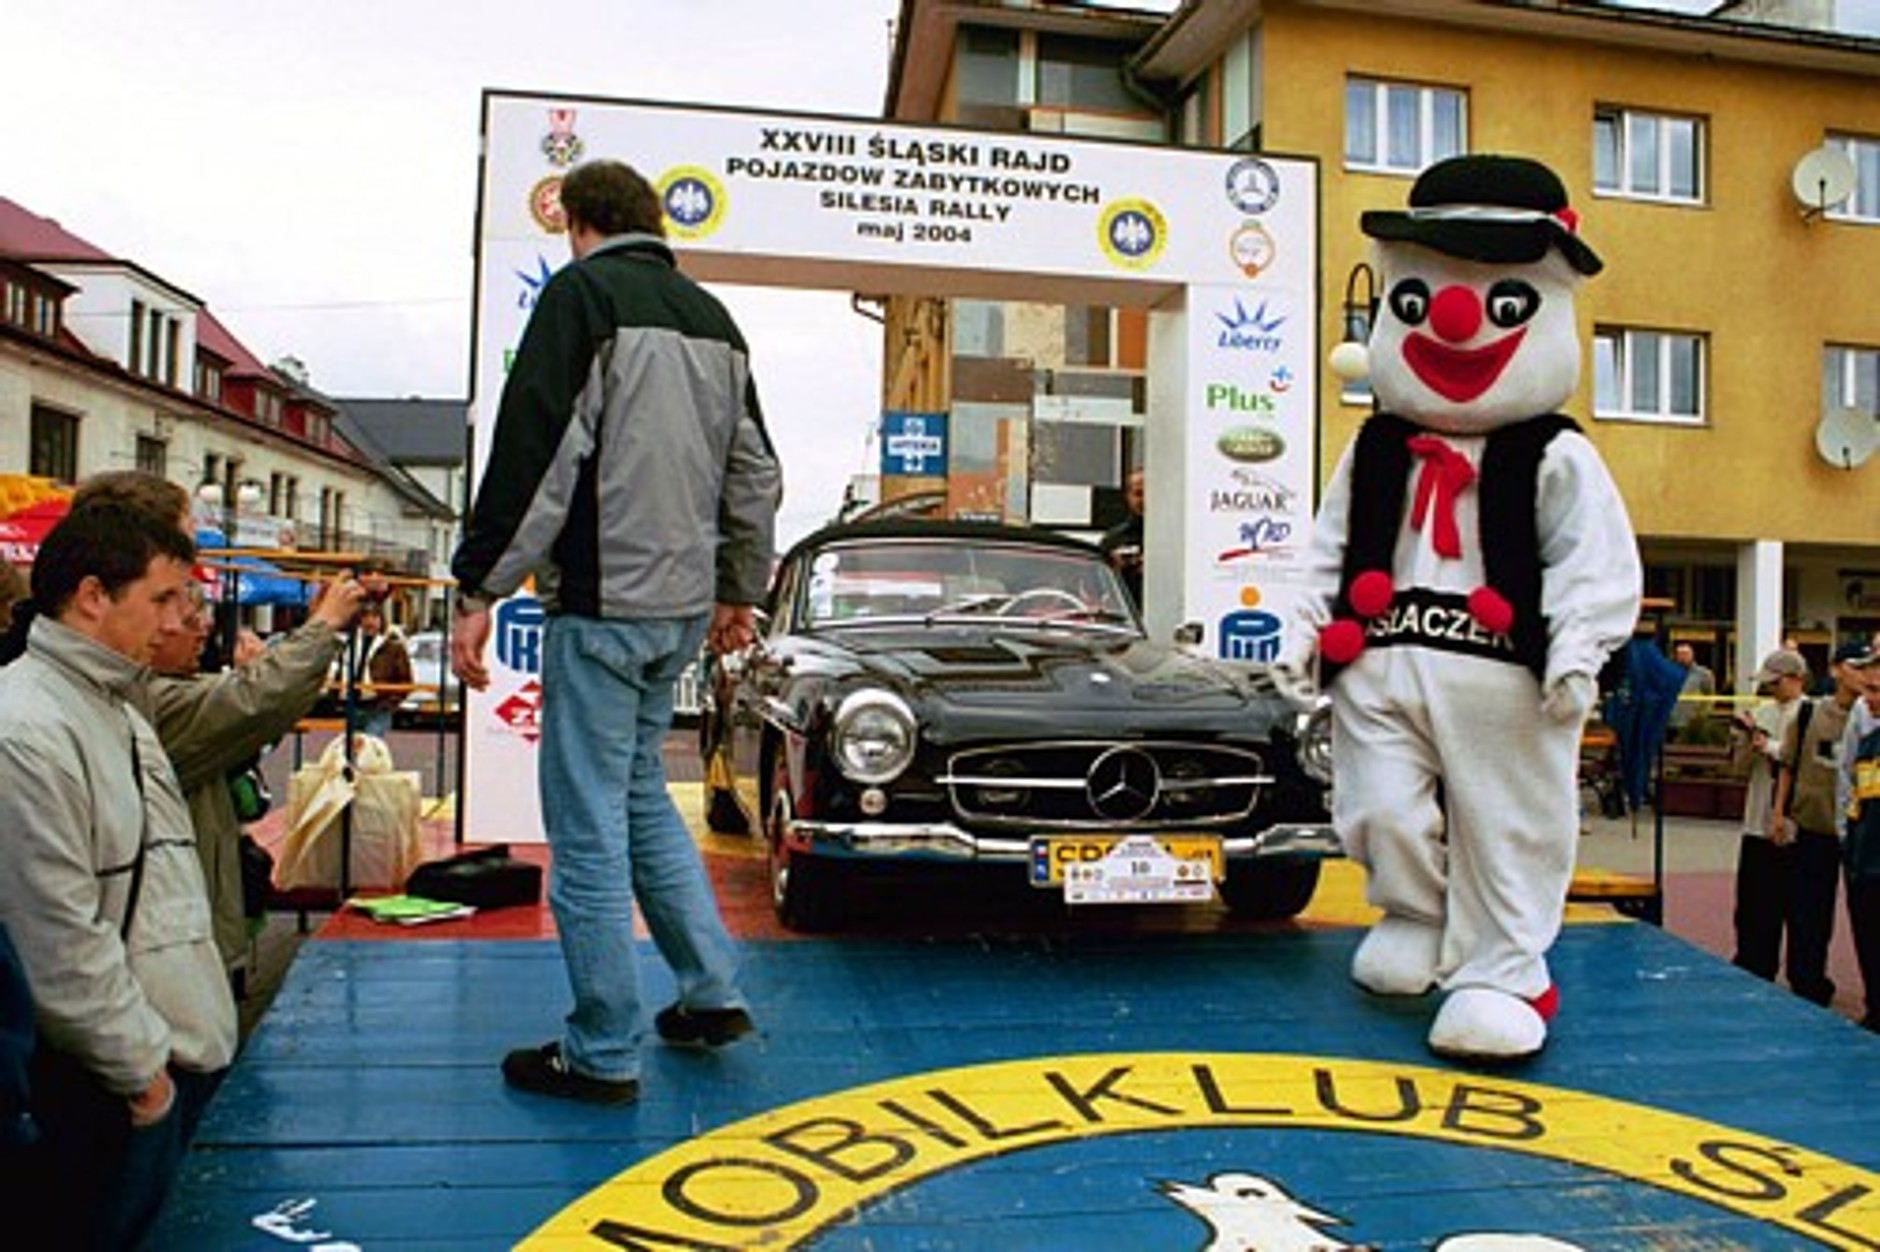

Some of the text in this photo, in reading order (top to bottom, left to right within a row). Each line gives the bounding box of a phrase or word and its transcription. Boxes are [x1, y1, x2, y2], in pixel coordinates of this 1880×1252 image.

[761, 127, 1071, 173] XXVIII ŚLĄSKI RAJD
[894, 169, 1100, 205] ZABYTKOWYCH
[820, 190, 1012, 223] SILESIA RALLY
[857, 221, 972, 243] maj 2004
[1206, 383, 1274, 412] Plus
[1210, 488, 1287, 513] JAGUAR
